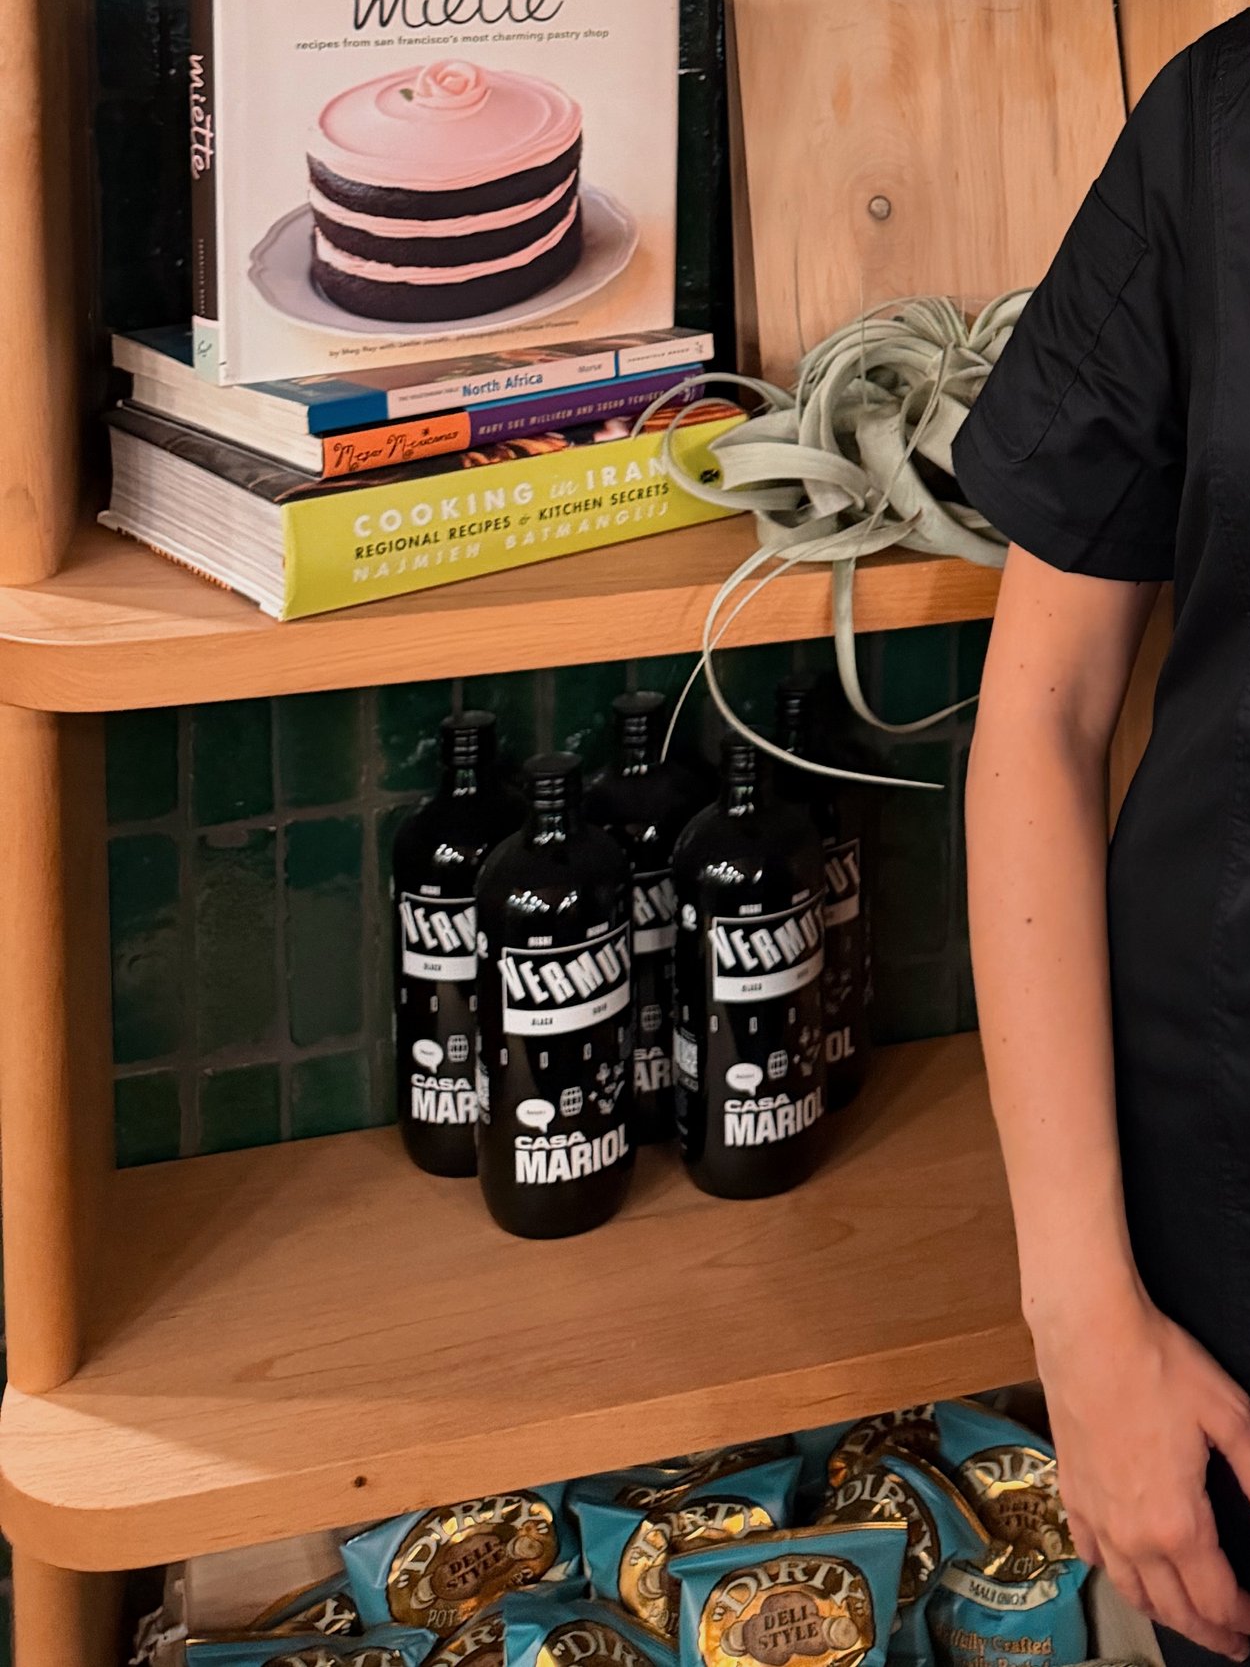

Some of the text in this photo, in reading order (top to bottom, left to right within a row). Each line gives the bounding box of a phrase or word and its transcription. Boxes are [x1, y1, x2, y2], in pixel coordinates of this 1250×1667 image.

[296, 29, 609, 52] recipes from san francisco's most charming pastry shop
[189, 55, 214, 180] miette
[462, 380, 500, 397] North
[504, 372, 543, 390] Africa
[353, 457, 668, 538] COOKING in IRAN
[354, 530, 441, 559] REGIONAL
[449, 516, 511, 540] RECIPES
[539, 496, 602, 521] KITCHEN
[610, 483, 669, 505] SECRETS
[353, 542, 481, 583] NAJMIEH
[497, 935, 630, 1005] VERMUT
[411, 1074, 472, 1090] CASA
[724, 1093, 791, 1112] CASA
[724, 1086, 824, 1147] MARIOL
[515, 1131, 586, 1149] CASA
[515, 1123, 628, 1184] MARIOL
[445, 1552, 510, 1591] STYLE
[448, 1541, 501, 1575] DELI
[764, 1605, 807, 1632] DELI
[758, 1623, 819, 1651] STYLE
